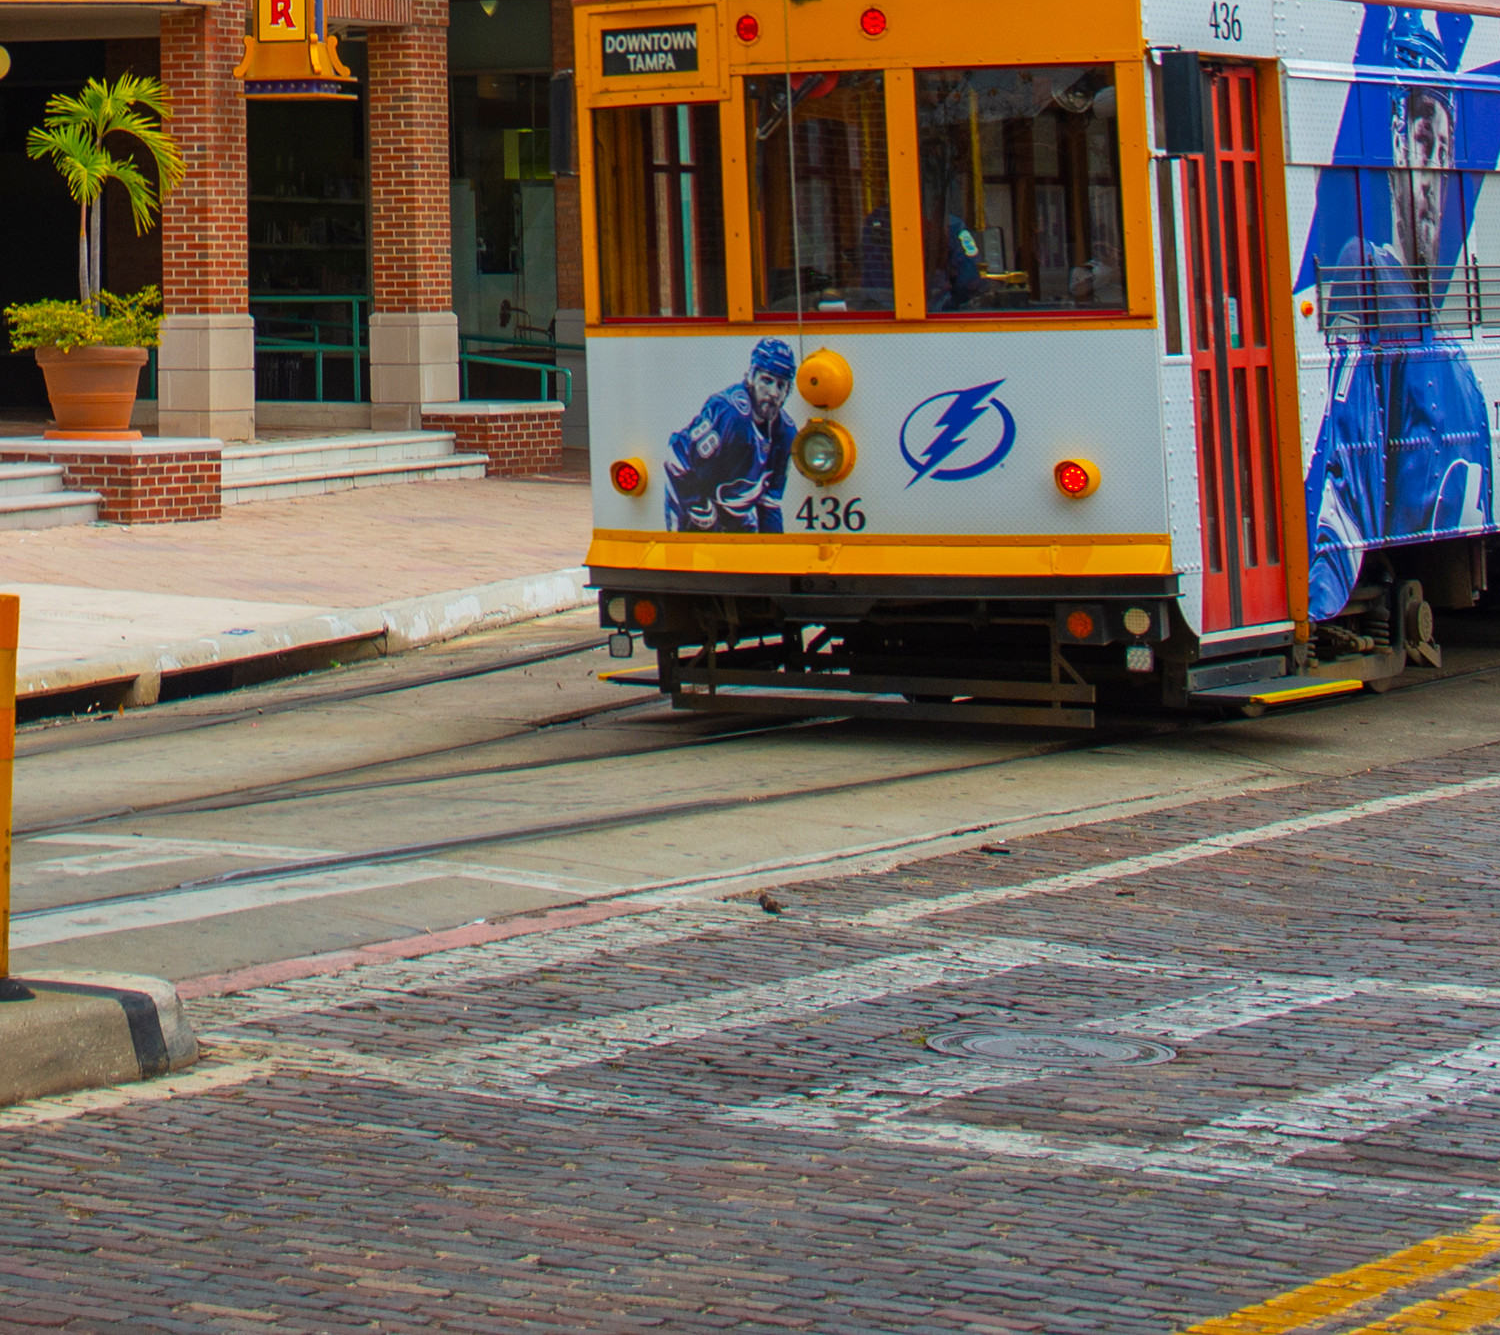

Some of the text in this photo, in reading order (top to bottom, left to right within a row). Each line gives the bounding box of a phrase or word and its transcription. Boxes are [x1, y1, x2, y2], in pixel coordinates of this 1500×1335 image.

[1209, 0, 1242, 43] 436
[604, 30, 697, 54] DOWNTOWN
[626, 52, 677, 73] TAMPA
[690, 418, 720, 459] 86
[796, 496, 866, 532] 436
